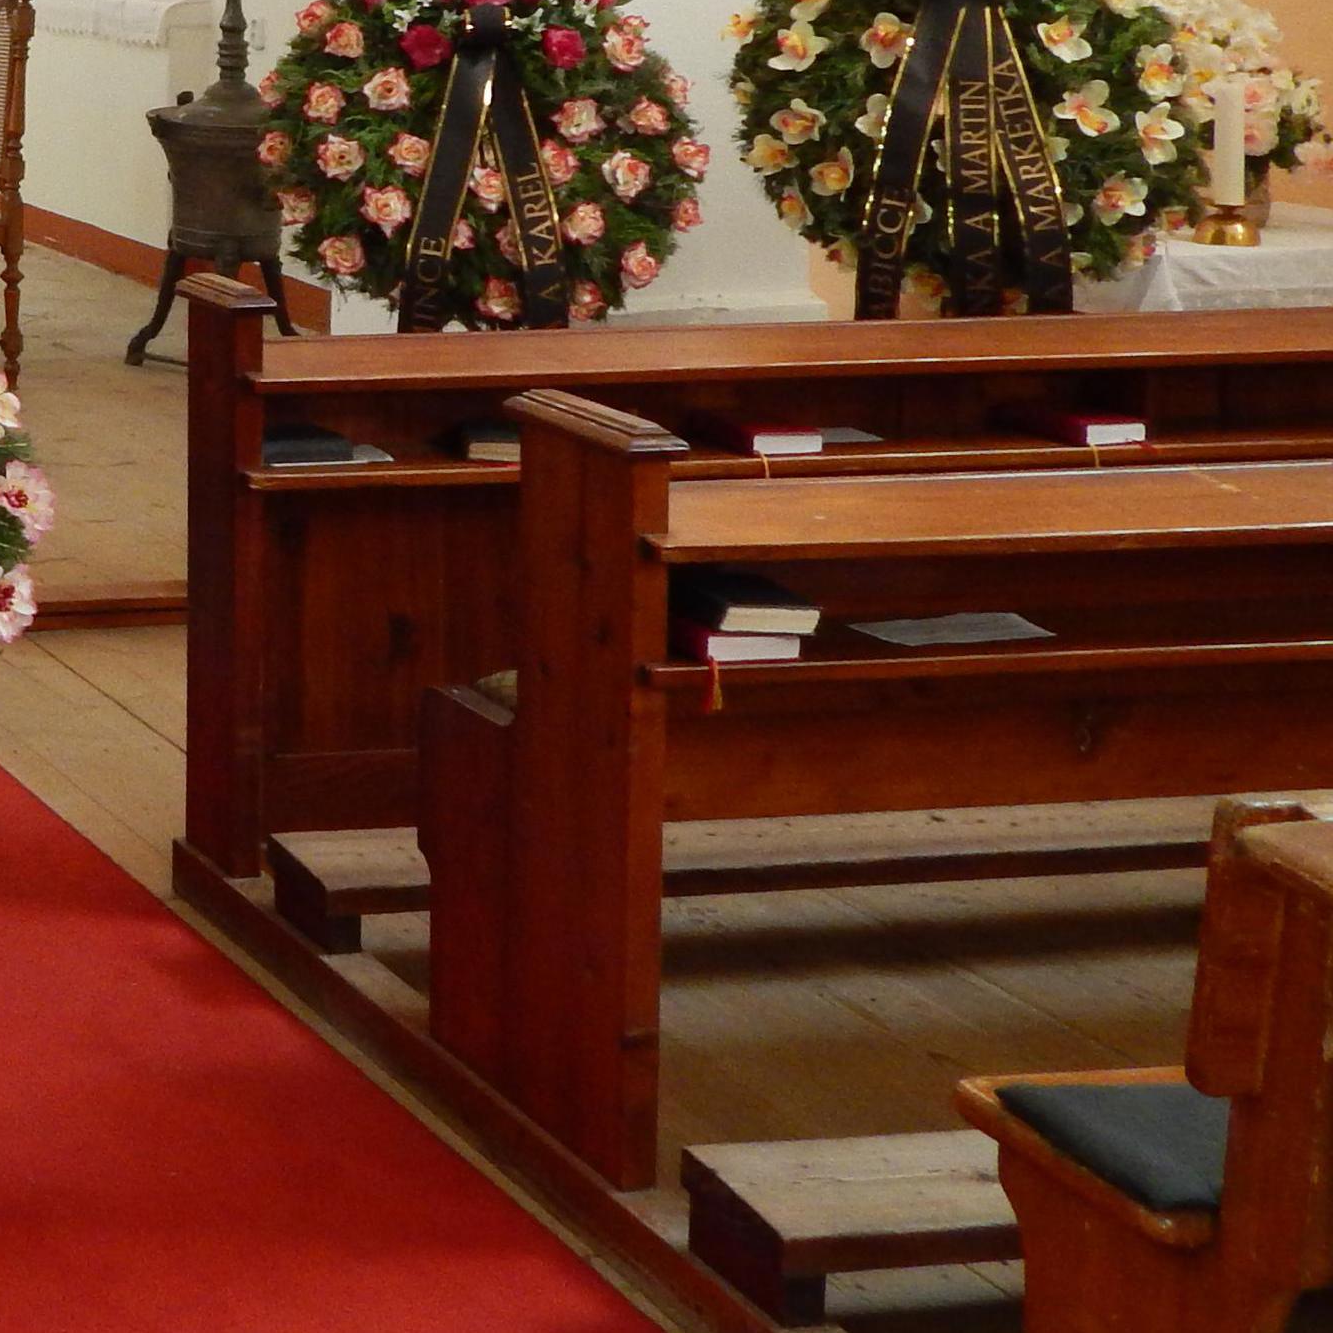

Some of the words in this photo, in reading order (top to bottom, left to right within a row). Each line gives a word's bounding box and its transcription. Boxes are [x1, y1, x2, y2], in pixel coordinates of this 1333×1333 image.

[959, 80, 990, 194] MARTIN
[993, 58, 1060, 232] MARKÉTKA
[517, 161, 558, 266] KAREL
[963, 211, 993, 233] A
